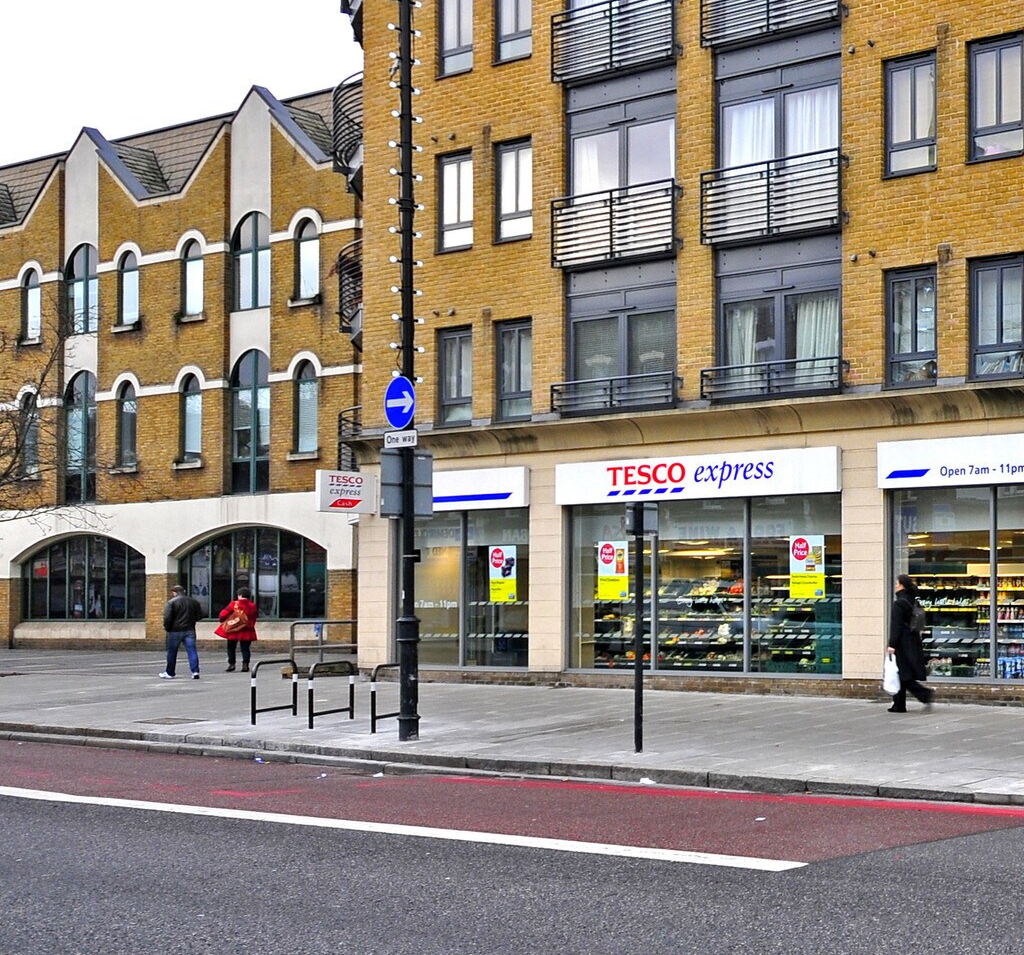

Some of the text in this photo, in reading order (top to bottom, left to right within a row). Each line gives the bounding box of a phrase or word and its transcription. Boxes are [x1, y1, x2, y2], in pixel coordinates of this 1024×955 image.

[386, 435, 415, 444] One way
[606, 461, 774, 489] TESCO express
[940, 466, 966, 478] Open
[968, 464, 990, 475] 7am
[329, 475, 364, 485] TESCO
[329, 487, 362, 496] express
[793, 548, 808, 556] Price
